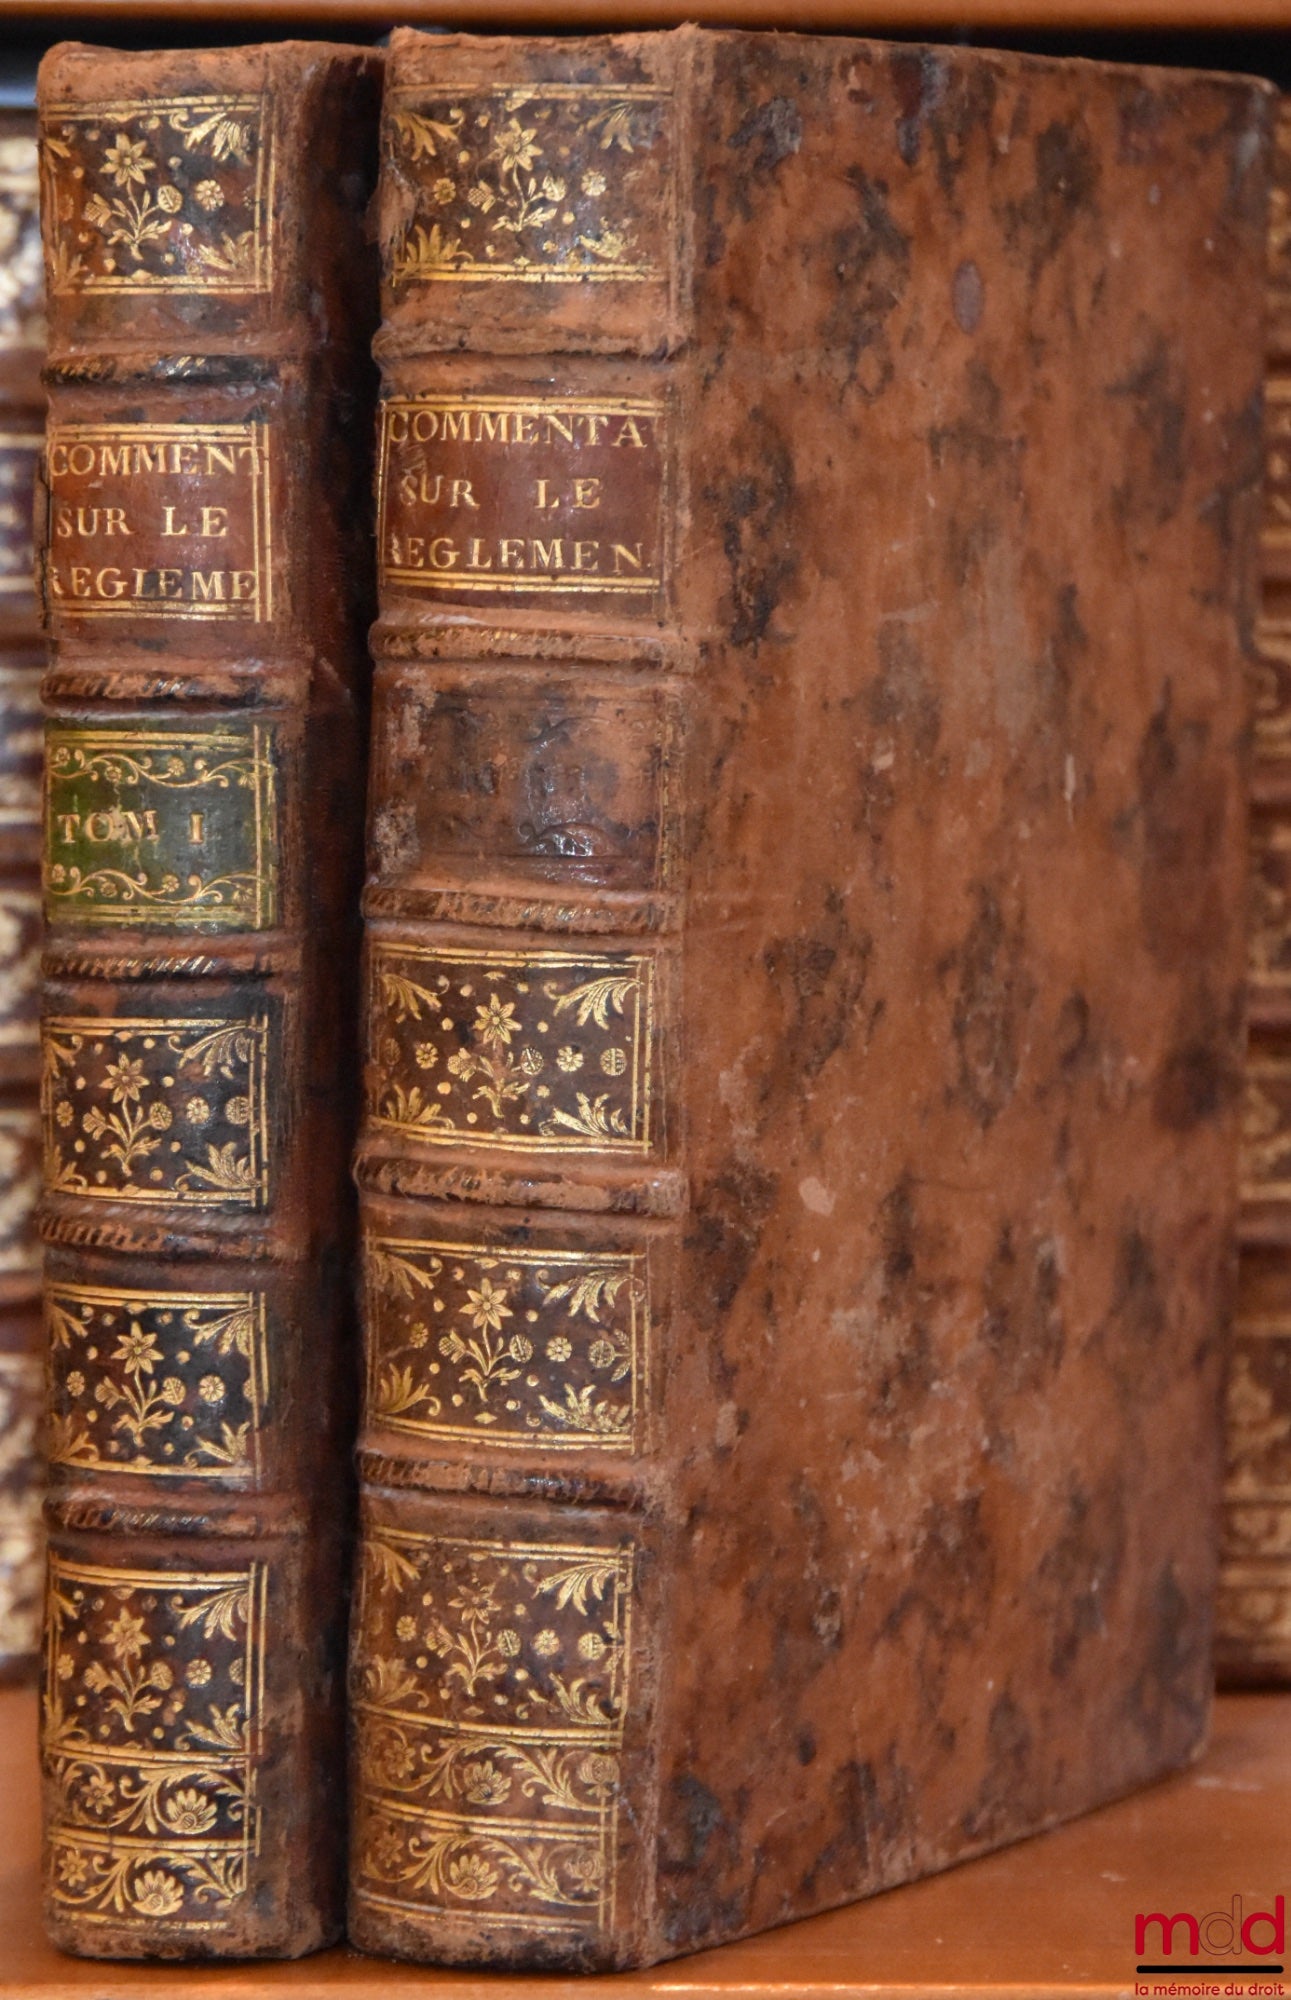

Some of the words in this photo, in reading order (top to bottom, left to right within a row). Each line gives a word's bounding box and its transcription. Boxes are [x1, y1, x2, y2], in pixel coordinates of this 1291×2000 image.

[387, 410, 648, 449] COMMENTA
[50, 443, 263, 477] COMMENT
[400, 473, 480, 511] SUR
[534, 477, 602, 510] LE
[56, 506, 135, 538] SUR
[160, 505, 229, 538] LE
[188, 812, 205, 845] I
